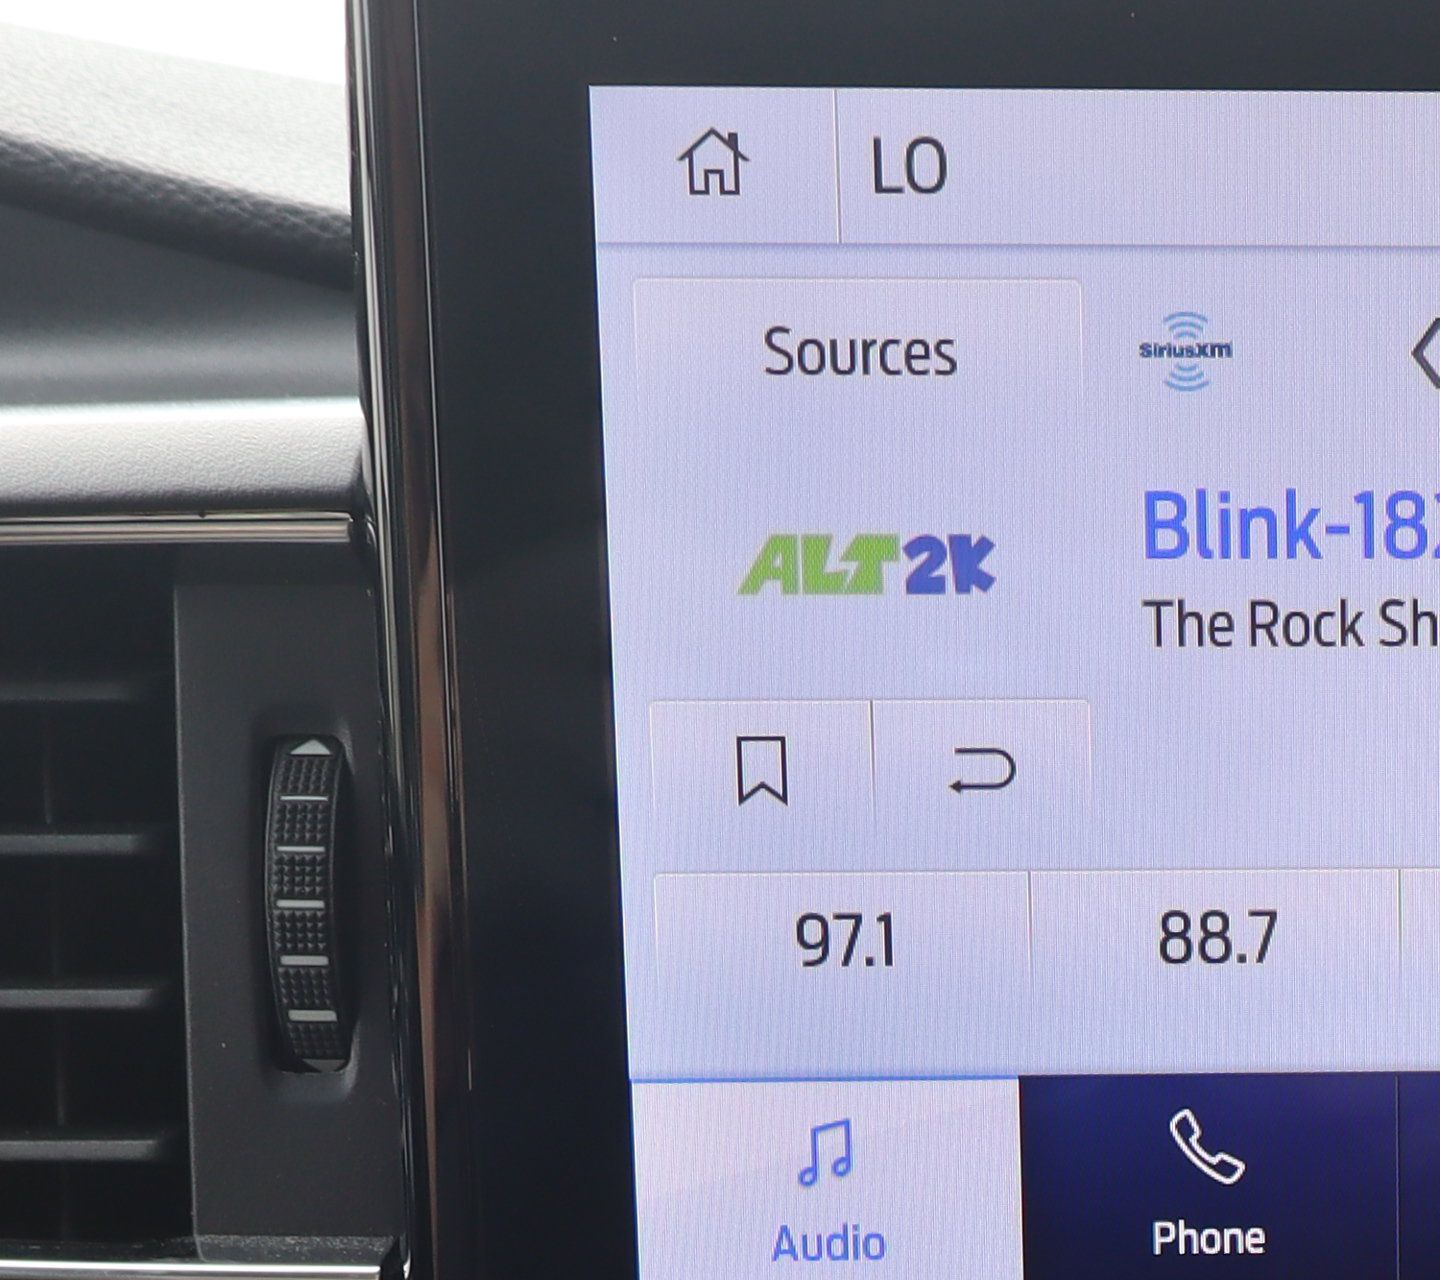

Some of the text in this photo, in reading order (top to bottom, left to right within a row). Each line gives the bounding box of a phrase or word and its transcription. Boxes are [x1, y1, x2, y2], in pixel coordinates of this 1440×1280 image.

[872, 136, 948, 196] LO
[764, 325, 958, 377] Sources
[738, 533, 996, 595] ALT2K
[1143, 599, 1234, 648] The
[1250, 599, 1364, 648] Rock
[794, 912, 896, 968] 97.1
[1158, 909, 1278, 966] 88.7
[772, 1224, 887, 1263] Audio
[1153, 1220, 1266, 1257] Phone
